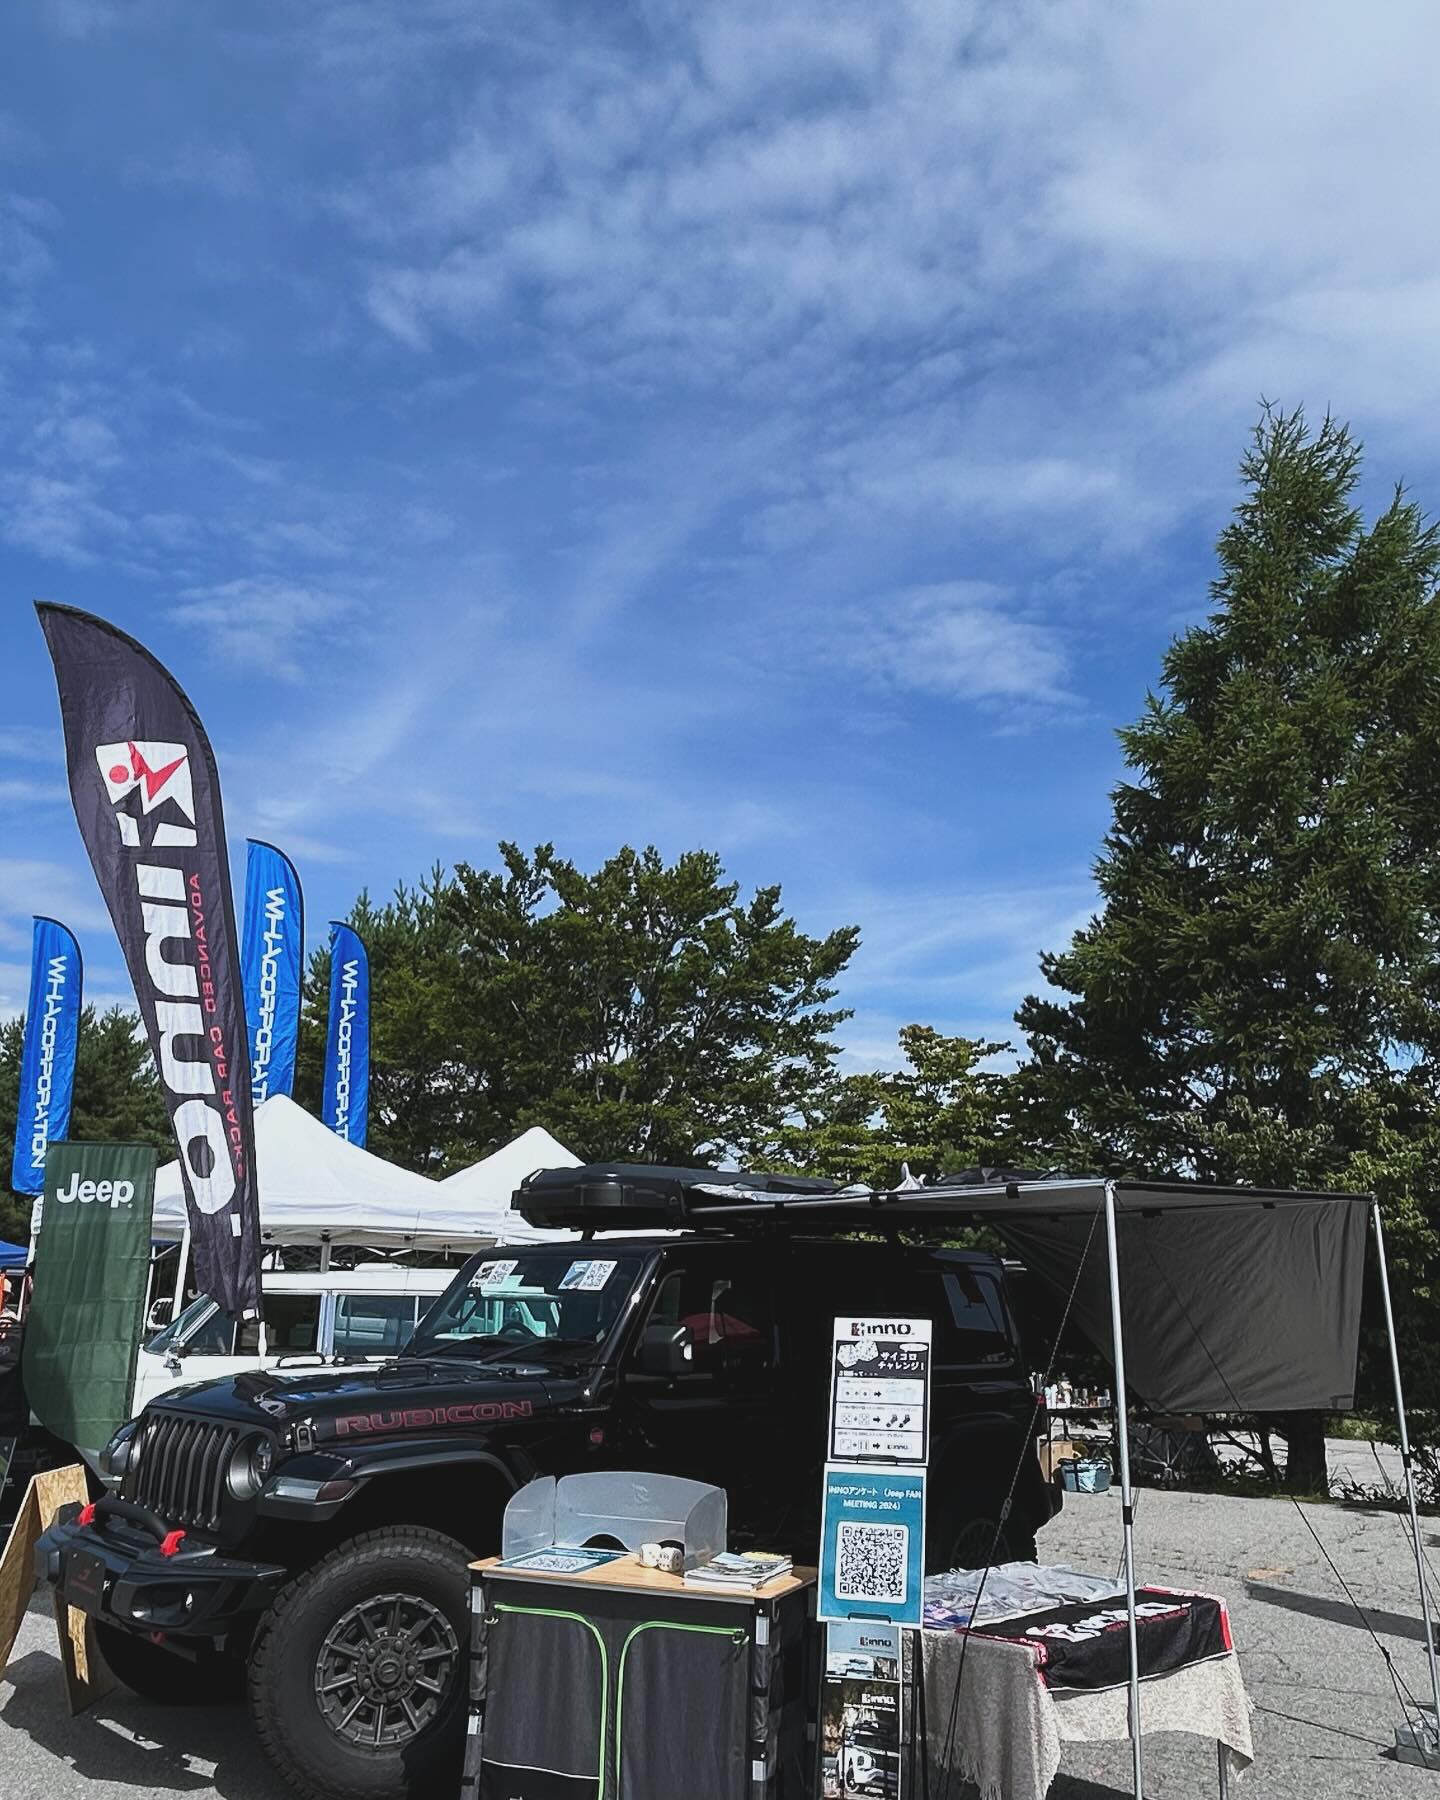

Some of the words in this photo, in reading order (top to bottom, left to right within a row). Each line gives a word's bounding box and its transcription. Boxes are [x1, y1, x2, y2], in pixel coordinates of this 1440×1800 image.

[252, 886, 285, 1103] WHACORPORATI
[31, 956, 67, 1168] WHACORPORATION
[336, 960, 358, 1142] WHACORPORAT
[56, 1172, 133, 1208] Jeep
[336, 1400, 534, 1435] RUBICON
[843, 1499, 878, 1510] MEETING
[905, 1490, 922, 1499] FAN
